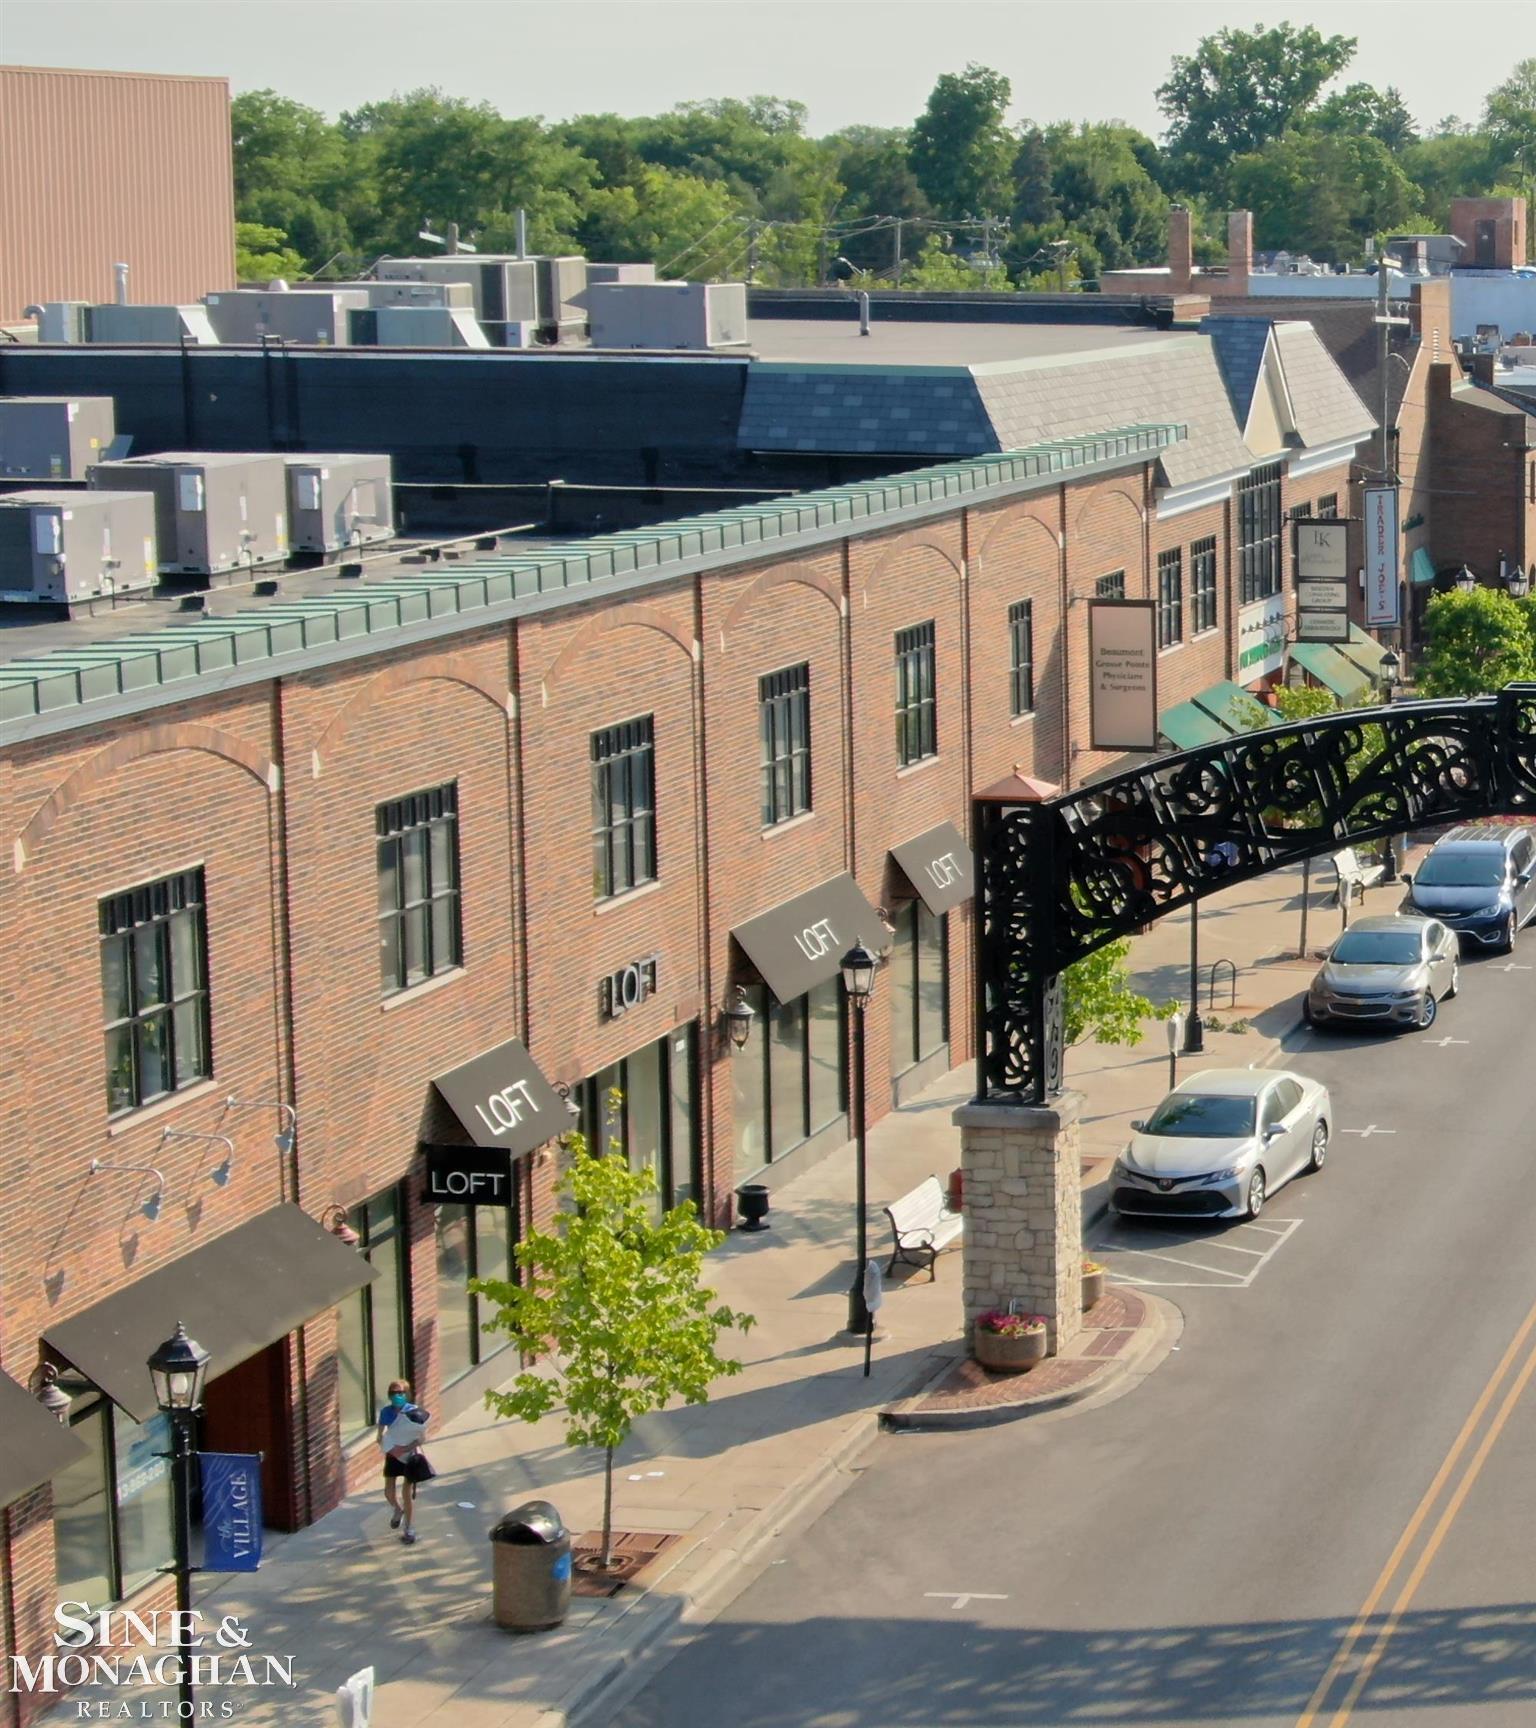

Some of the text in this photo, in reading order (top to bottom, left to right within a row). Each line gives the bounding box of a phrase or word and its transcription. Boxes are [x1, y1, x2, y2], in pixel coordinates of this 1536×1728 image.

[1376, 494, 1385, 556] TRADER
[1100, 647, 1143, 656] Beaumont
[924, 852, 964, 889] LOFT
[793, 918, 840, 961] LOFT
[607, 952, 660, 1018] LOFT
[474, 1079, 540, 1136] LOFT
[431, 1171, 505, 1195] LOFT
[230, 1470, 251, 1558] VILLAGE
